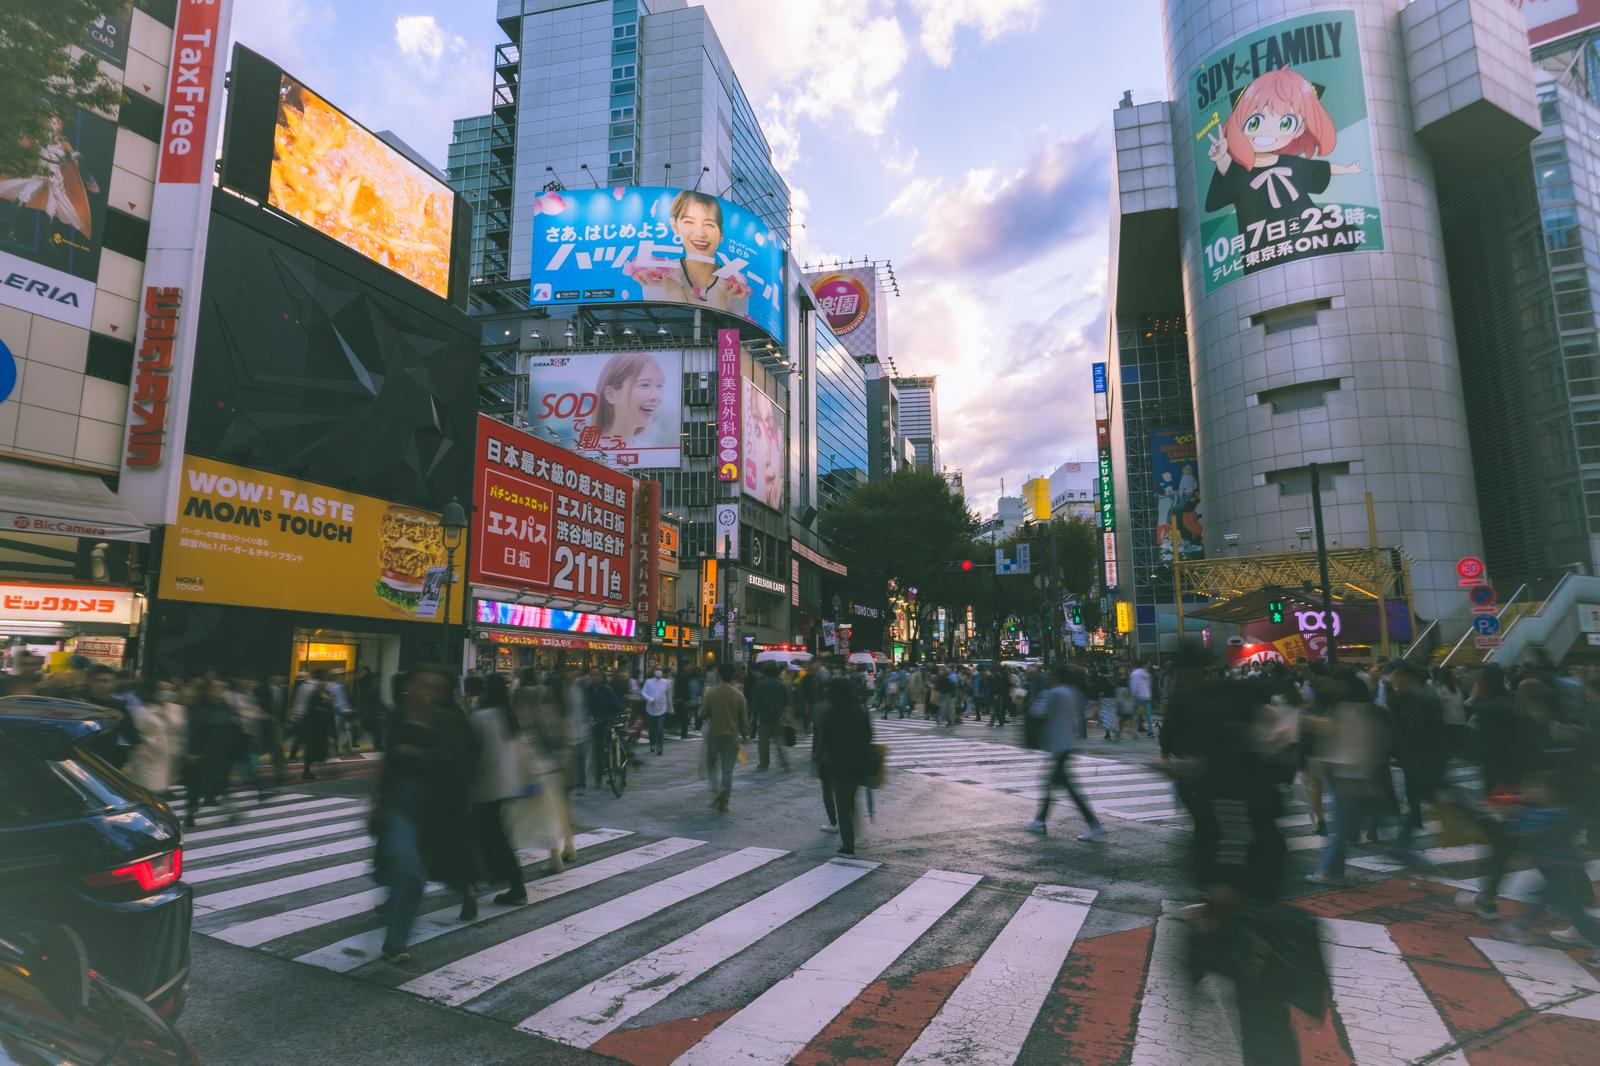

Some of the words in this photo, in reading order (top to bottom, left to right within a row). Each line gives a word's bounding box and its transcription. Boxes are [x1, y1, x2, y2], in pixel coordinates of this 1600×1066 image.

[169, 28, 211, 156] TaxFree
[1212, 240, 1294, 281] テレビ東京系
[1295, 234, 1328, 252] ON
[1333, 230, 1367, 246] AIR
[537, 392, 598, 419] SOD
[721, 348, 737, 434] 品川美容外科
[573, 416, 585, 432] で
[487, 437, 627, 509] 日本最大級の超大型店
[187, 469, 274, 504] WOW!
[279, 489, 355, 523] TASTE
[1100, 460, 1113, 526] ビリヤード・ダーツ
[33, 519, 106, 536] BicCamera
[277, 513, 353, 544] TOUCH
[487, 511, 548, 545] エスパス
[556, 495, 625, 534] エスパス日拓
[556, 519, 625, 557] 渋谷地区合計
[503, 547, 531, 569] 日拓
[553, 546, 611, 598] 2111
[610, 570, 622, 593] 台
[1463, 563, 1479, 574] 30
[637, 532, 649, 623] エスパス日拓
[749, 574, 772, 590] EXCELSIOR
[3, 595, 115, 613] ビックカメラ
[609, 591, 623, 600] OVER
[1295, 610, 1341, 637] 109
